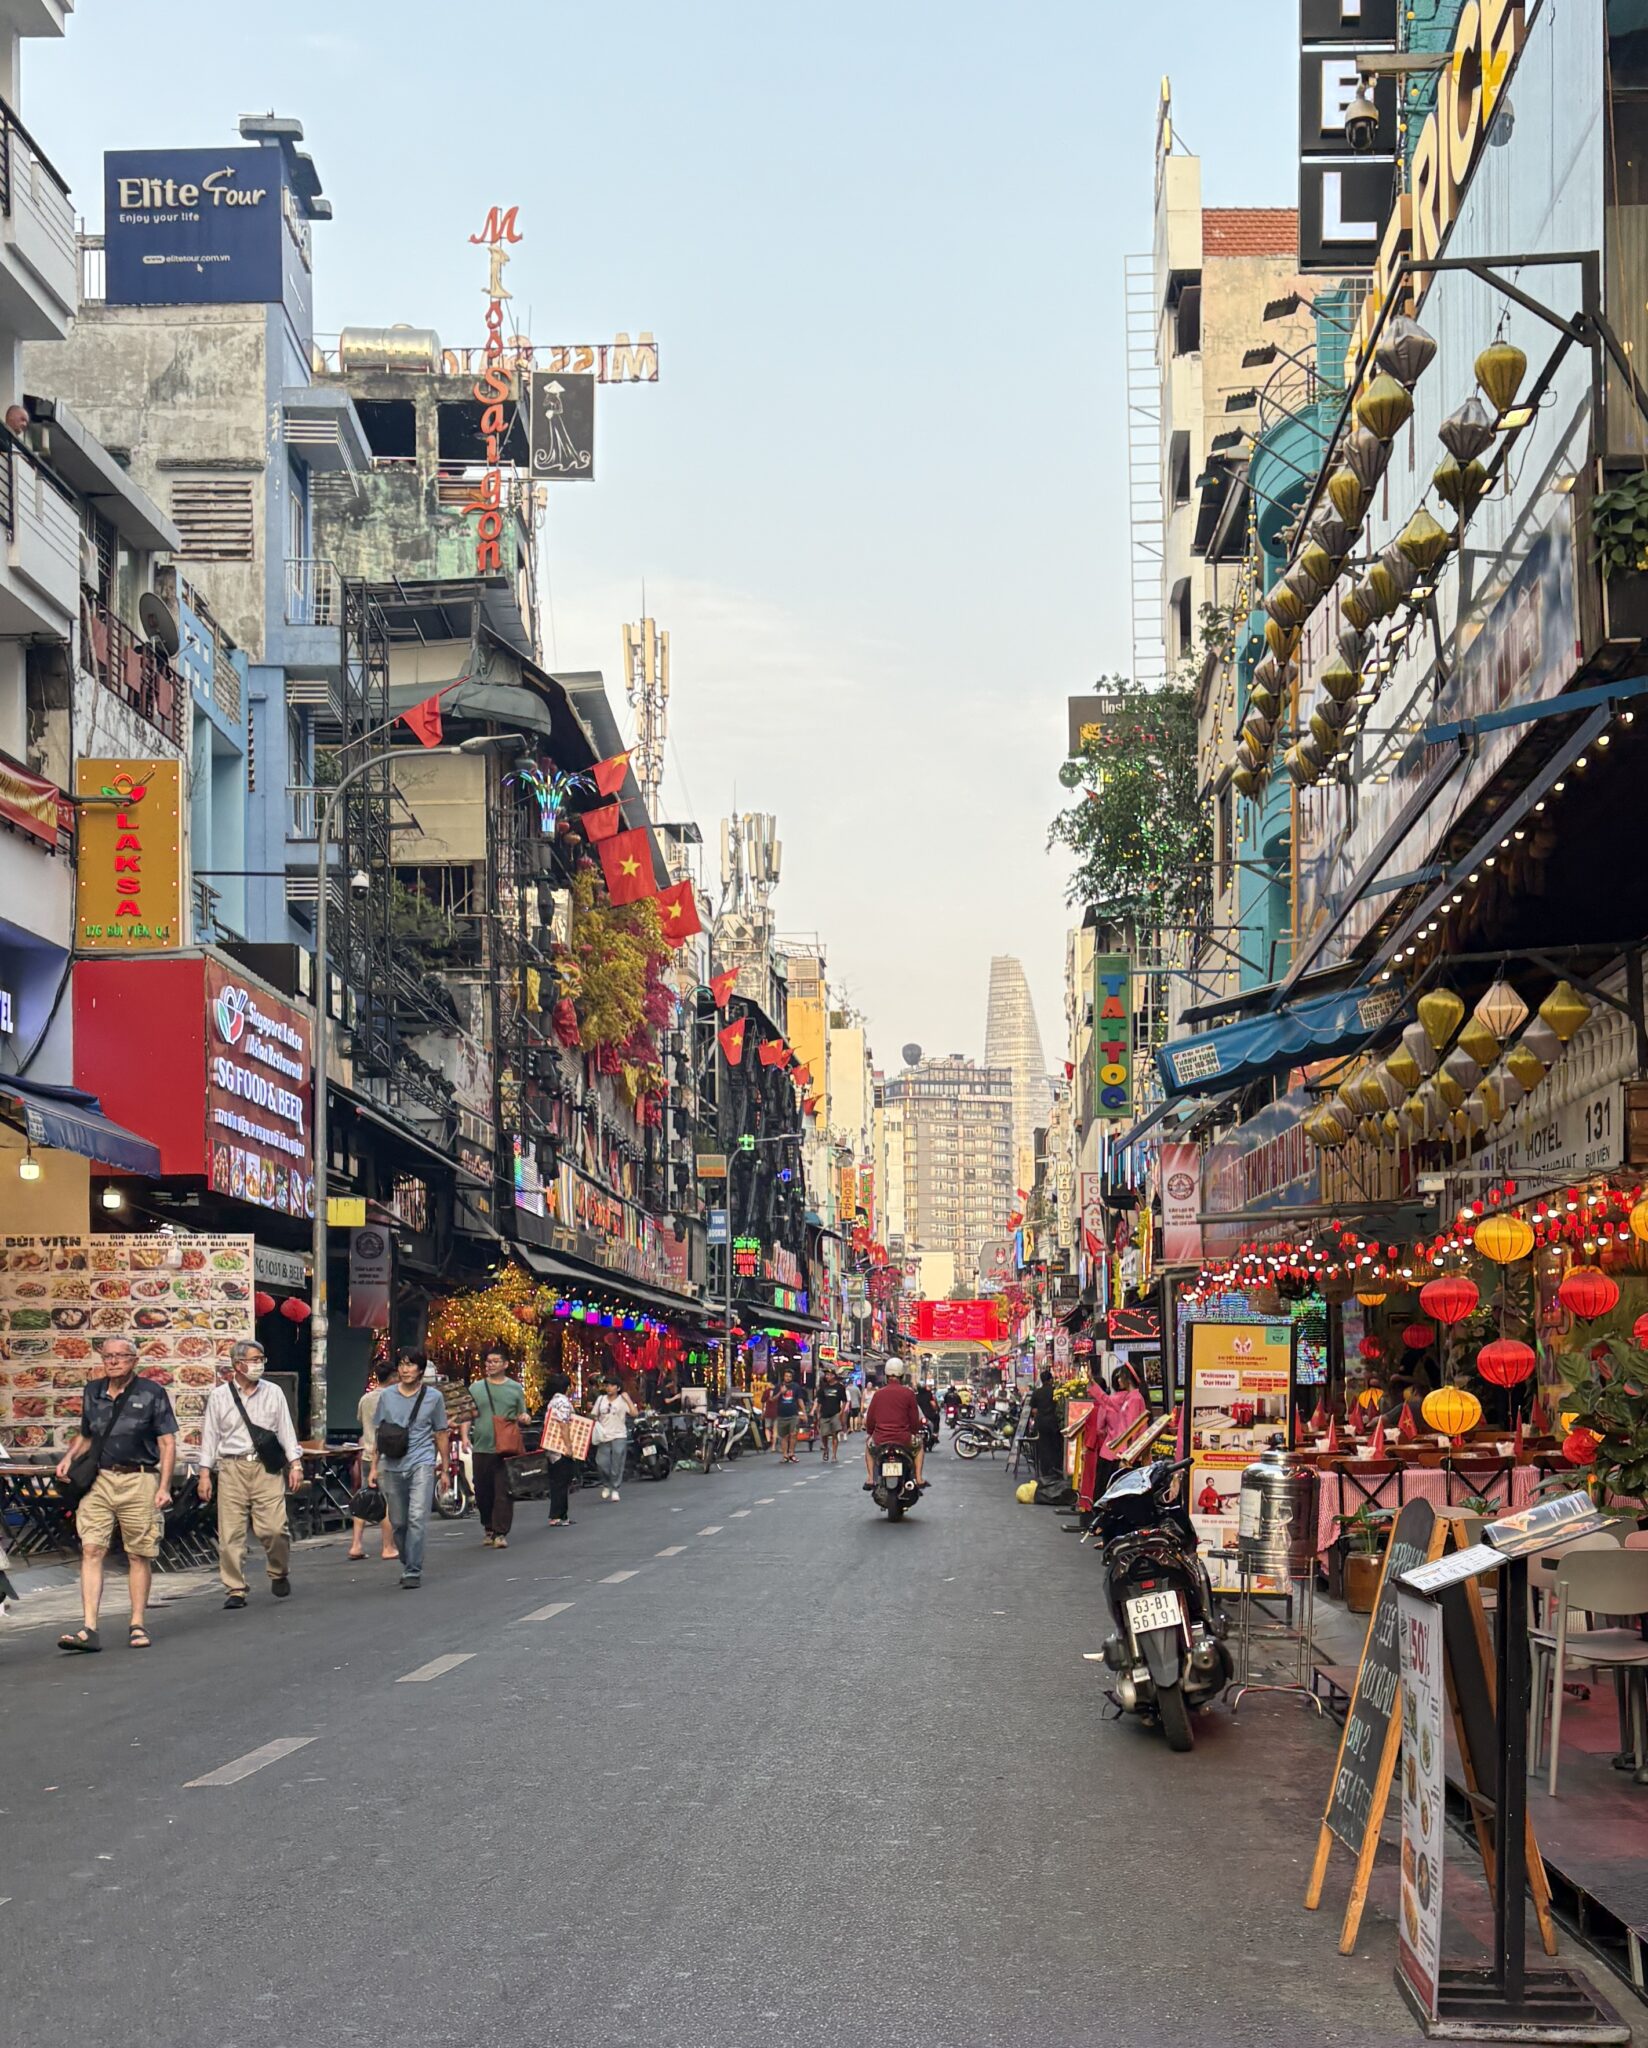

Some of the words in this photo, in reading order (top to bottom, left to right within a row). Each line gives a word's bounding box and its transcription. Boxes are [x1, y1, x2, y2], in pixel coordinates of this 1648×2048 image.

[118, 177, 199, 208] Elite
[202, 166, 266, 206] Tour
[119, 213, 150, 224] Enjoy
[152, 214, 178, 224] your
[181, 212, 200, 222] life
[463, 367, 512, 572] Saigon
[115, 812, 142, 917] LAKSA
[249, 1003, 283, 1041] Singapore
[282, 1022, 303, 1051] Laksa
[249, 1034, 268, 1063] Asian
[1100, 974, 1127, 1109] TATTOO
[216, 1057, 234, 1092] SG
[235, 1066, 267, 1106] FOOD
[267, 1082, 278, 1113] &
[278, 1088, 304, 1135] BEER
[1526, 1121, 1562, 1161] HOTEL
[1585, 1097, 1611, 1143] 131
[1058, 1175, 1070, 1246] HOTEL
[6, 1235, 34, 1247] BÙI
[1132, 1609, 1176, 1630] 561.91
[1135, 1595, 1169, 1614] 63-B1
